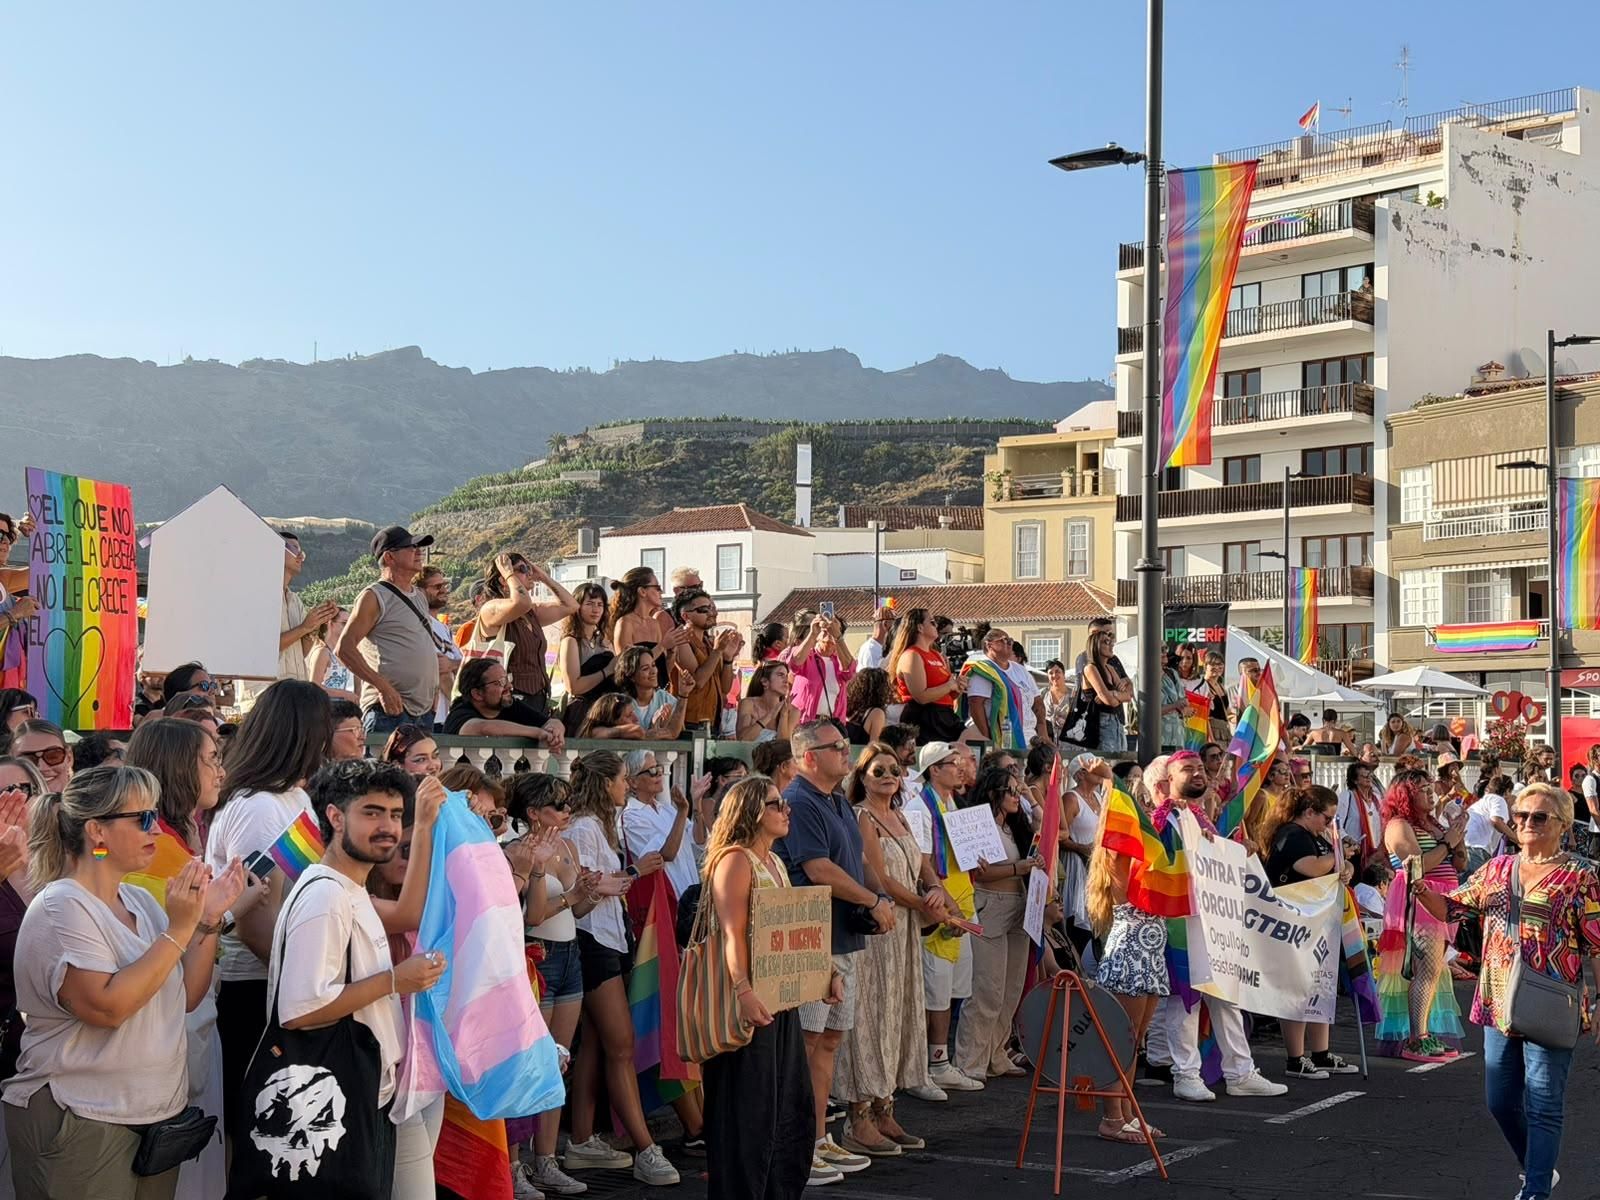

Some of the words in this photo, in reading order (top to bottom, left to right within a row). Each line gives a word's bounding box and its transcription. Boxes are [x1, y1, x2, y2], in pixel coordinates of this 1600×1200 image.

[42, 495, 64, 525] EL
[72, 498, 109, 531] QUE
[111, 507, 131, 536] NO
[32, 532, 73, 565] ABRE
[80, 536, 98, 566] LA
[100, 536, 136, 570] CABEZA
[36, 574, 57, 610] NO
[62, 576, 82, 612] LE
[87, 577, 128, 614] CRECE
[29, 615, 45, 646] EL
[1195, 852, 1237, 886] ONTRA
[1201, 890, 1244, 927] ORGULL
[1244, 908, 1312, 949] GTBIQ+
